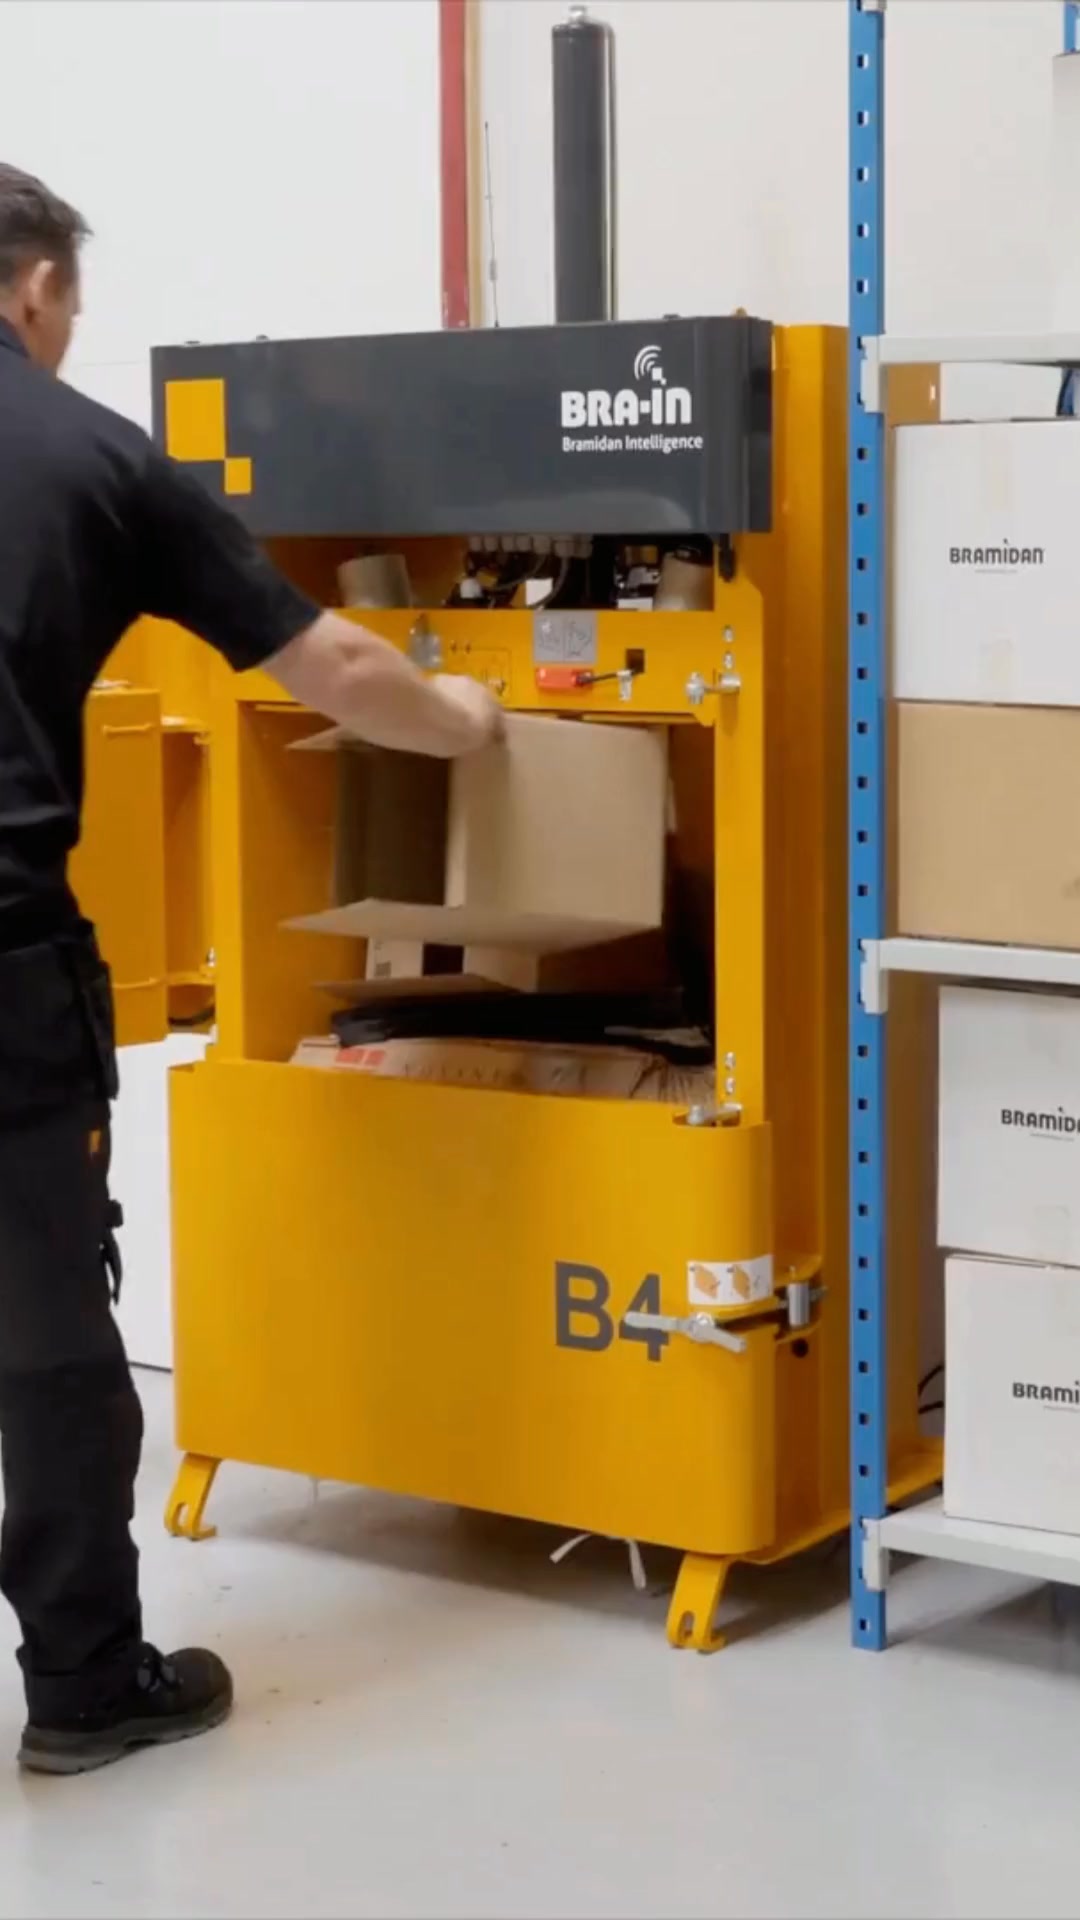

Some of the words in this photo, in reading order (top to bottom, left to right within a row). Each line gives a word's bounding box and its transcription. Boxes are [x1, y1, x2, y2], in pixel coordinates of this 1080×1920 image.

[562, 435, 623, 452] Bramidan
[625, 433, 704, 454] Intelligence
[1001, 1106, 1080, 1133] BRAMID
[555, 1260, 669, 1362] B4
